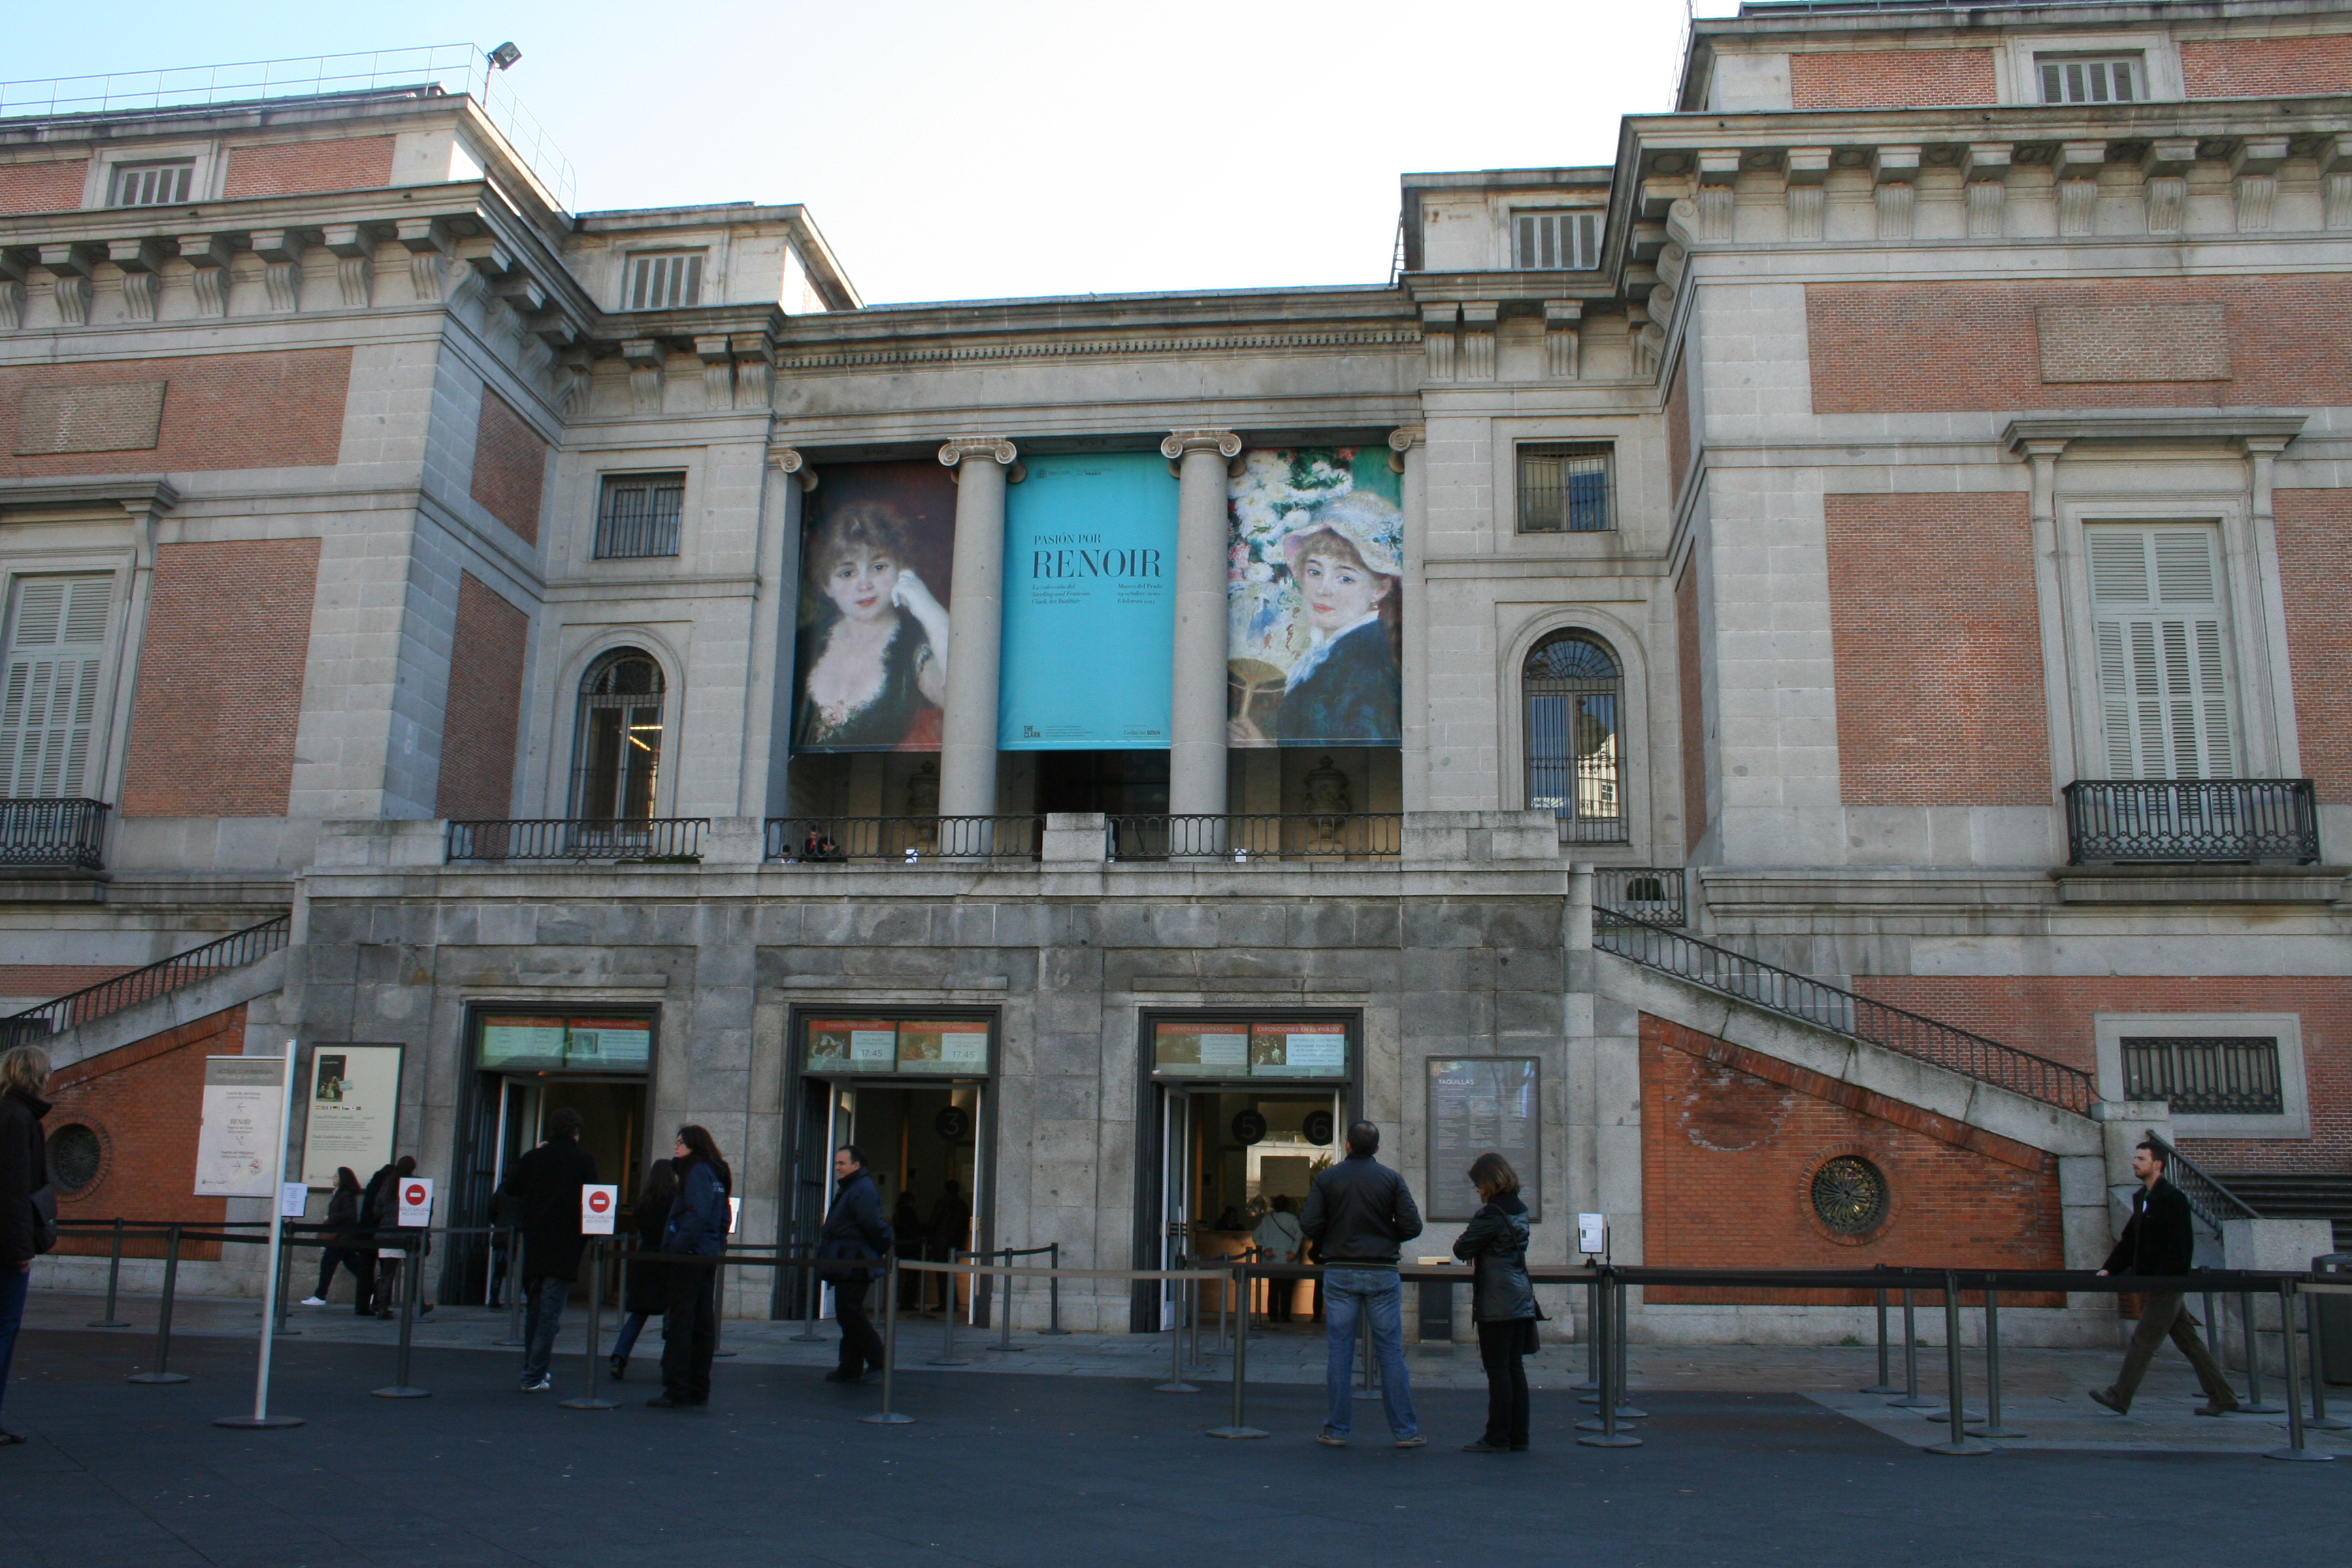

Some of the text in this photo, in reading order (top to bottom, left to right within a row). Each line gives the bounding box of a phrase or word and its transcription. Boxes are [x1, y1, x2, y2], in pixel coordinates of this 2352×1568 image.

[1034, 532, 1101, 544] PASIÓN POR
[1032, 549, 1162, 578] RENOIR
[944, 1113, 960, 1134] 3
[1241, 1116, 1256, 1139] 5
[1312, 1117, 1328, 1139] 6
